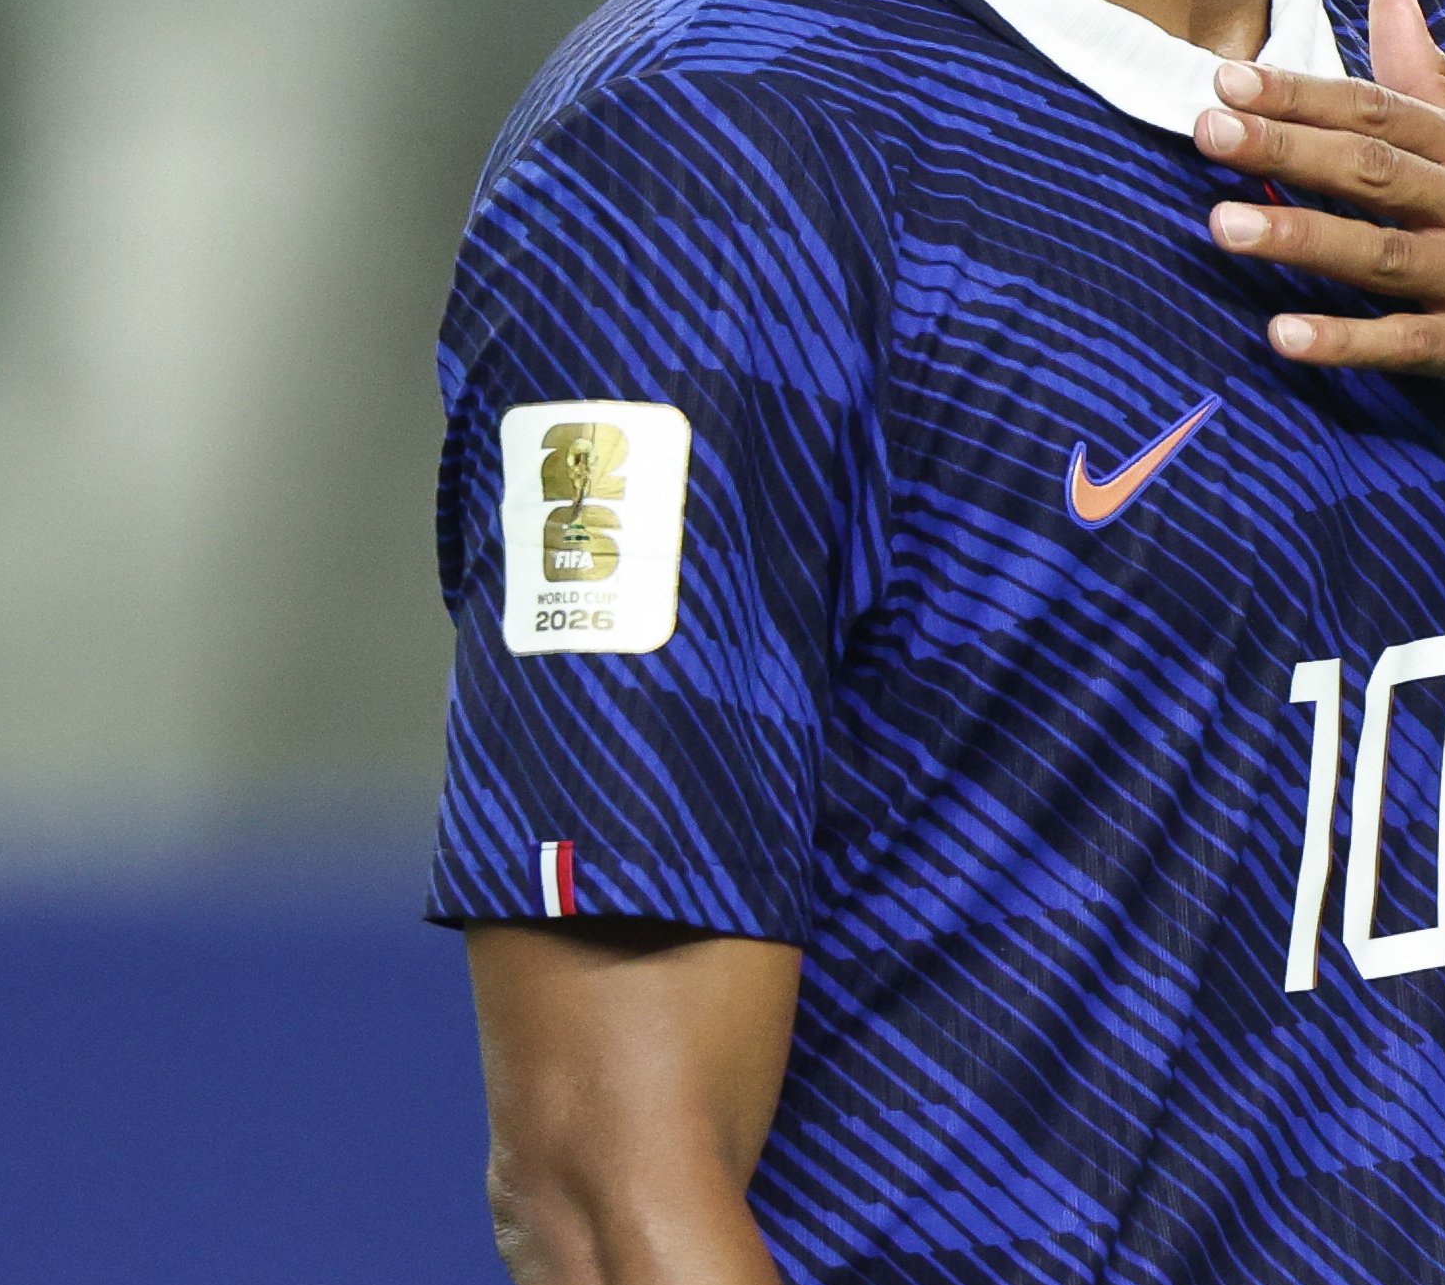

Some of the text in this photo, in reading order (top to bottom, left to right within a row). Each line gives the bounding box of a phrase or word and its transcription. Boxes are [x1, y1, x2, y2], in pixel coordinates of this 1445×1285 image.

[554, 551, 594, 569] FIFA
[536, 590, 617, 605] WORLD CUP
[536, 609, 614, 631] 2026
